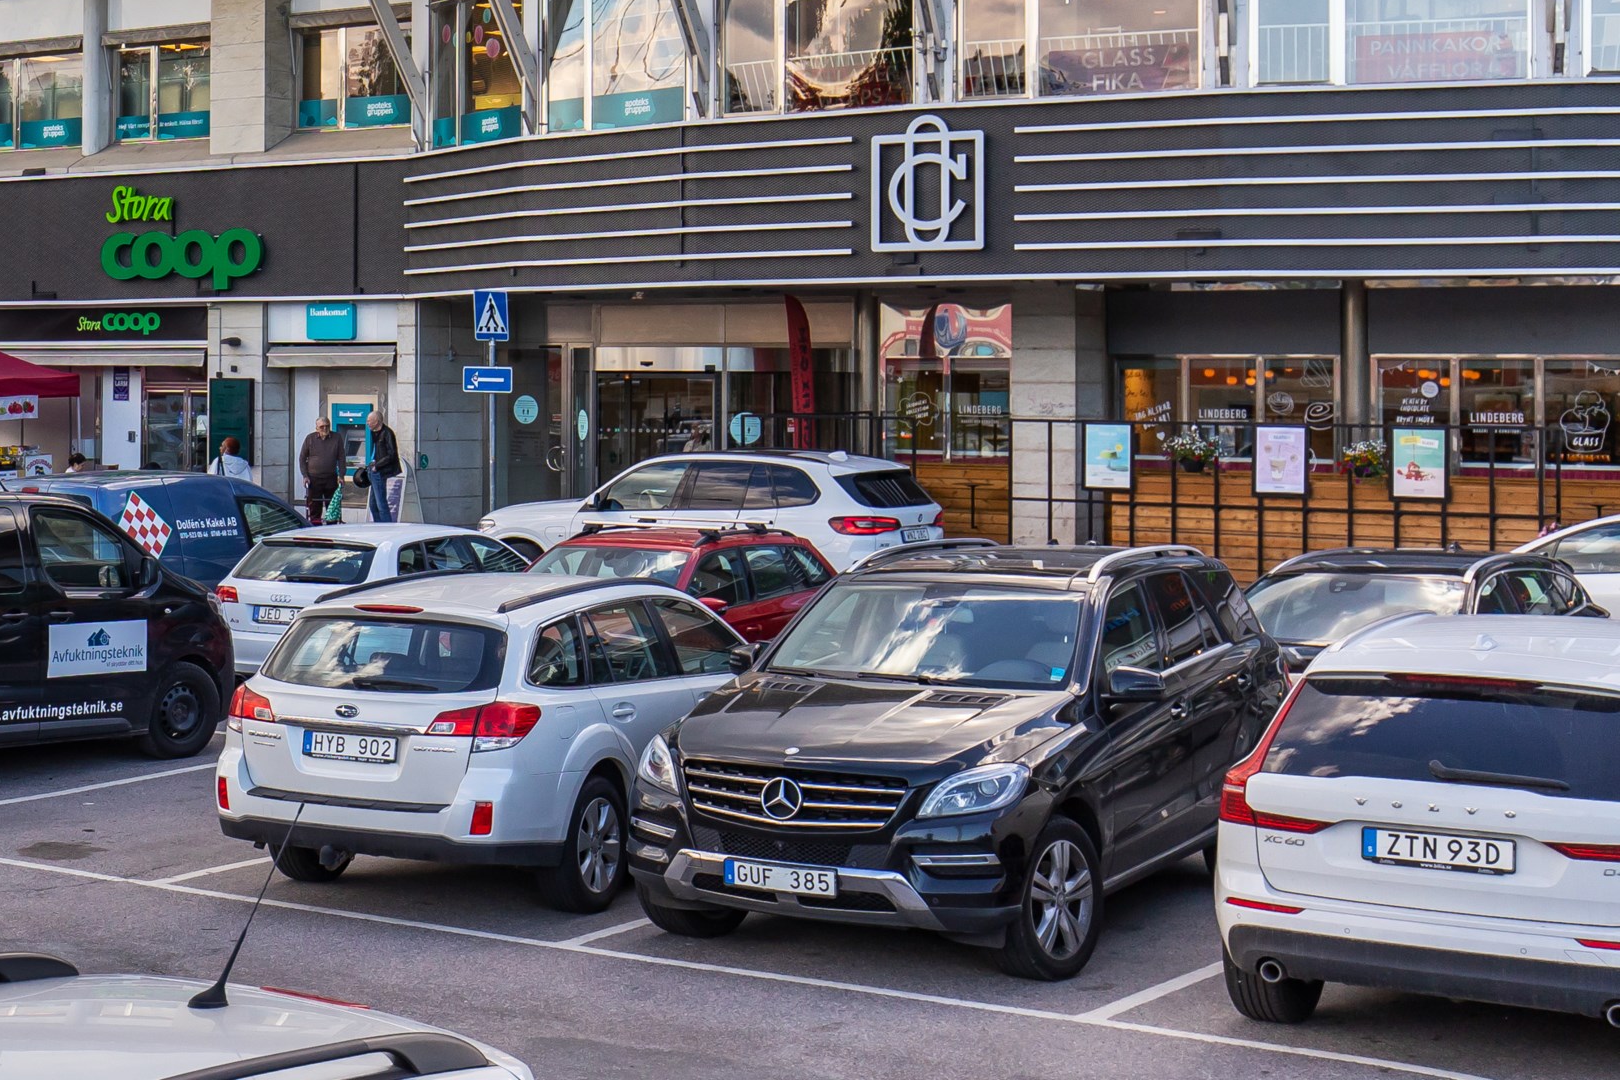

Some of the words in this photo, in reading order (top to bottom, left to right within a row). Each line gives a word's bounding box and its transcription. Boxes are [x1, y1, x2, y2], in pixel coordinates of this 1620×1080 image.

[1370, 35, 1502, 56] PANNKAKOR
[1082, 48, 1156, 69] GLASS
[1092, 72, 1144, 92] FIKA
[367, 102, 392, 110] apoteks
[625, 98, 650, 107] apoteks
[367, 107, 394, 117] gruppen
[625, 105, 651, 116] gruppen
[105, 186, 175, 223] Stora
[100, 228, 264, 290] coop
[310, 307, 350, 316] Bankomat
[77, 316, 100, 332] Stora
[102, 312, 159, 334] coop
[958, 405, 1002, 415] LINDEBERG
[1198, 408, 1247, 419] LINDEBERG
[1469, 412, 1525, 423] LINDEBERG
[1572, 436, 1600, 447] GLASS
[206, 517, 227, 528] Kakel
[227, 516, 238, 527] AB
[260, 608, 281, 620] JED
[52, 645, 144, 663] Avfuktningsteknik
[313, 732, 346, 752] HYB
[358, 737, 392, 757] 902
[413, 745, 456, 754] OUTBACK
[1355, 797, 1516, 819] VOLVO
[1386, 833, 1438, 859] ZTN
[1447, 840, 1500, 865] 93D
[737, 865, 773, 886] GUF
[789, 870, 830, 892] 385
